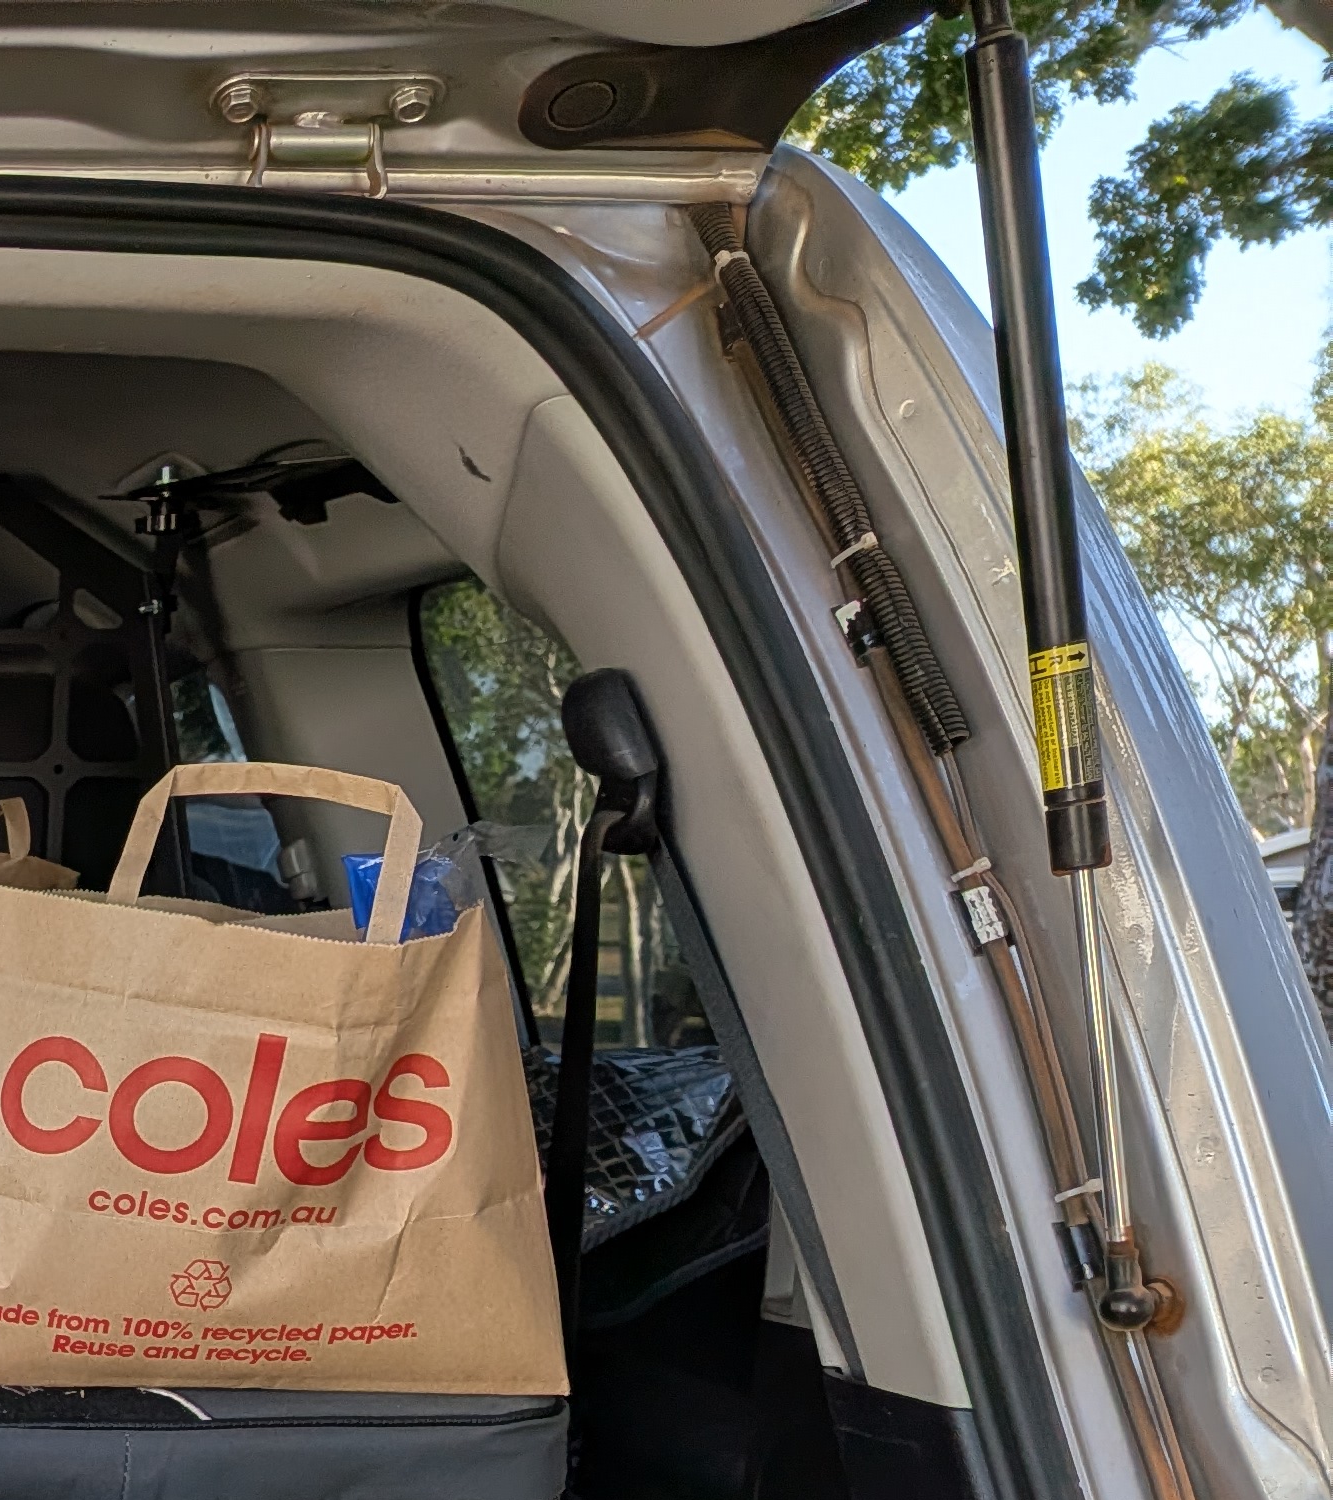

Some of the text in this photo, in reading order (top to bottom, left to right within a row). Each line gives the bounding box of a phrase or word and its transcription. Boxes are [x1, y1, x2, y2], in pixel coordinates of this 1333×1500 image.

[0, 1033, 453, 1186] coles
[87, 1188, 338, 1230] coles.com.au
[46, 1310, 111, 1336] from
[121, 1317, 193, 1341] 100%
[200, 1320, 323, 1346] recycled
[328, 1317, 418, 1346] paper.
[52, 1335, 313, 1365] Reuse and recycle.
